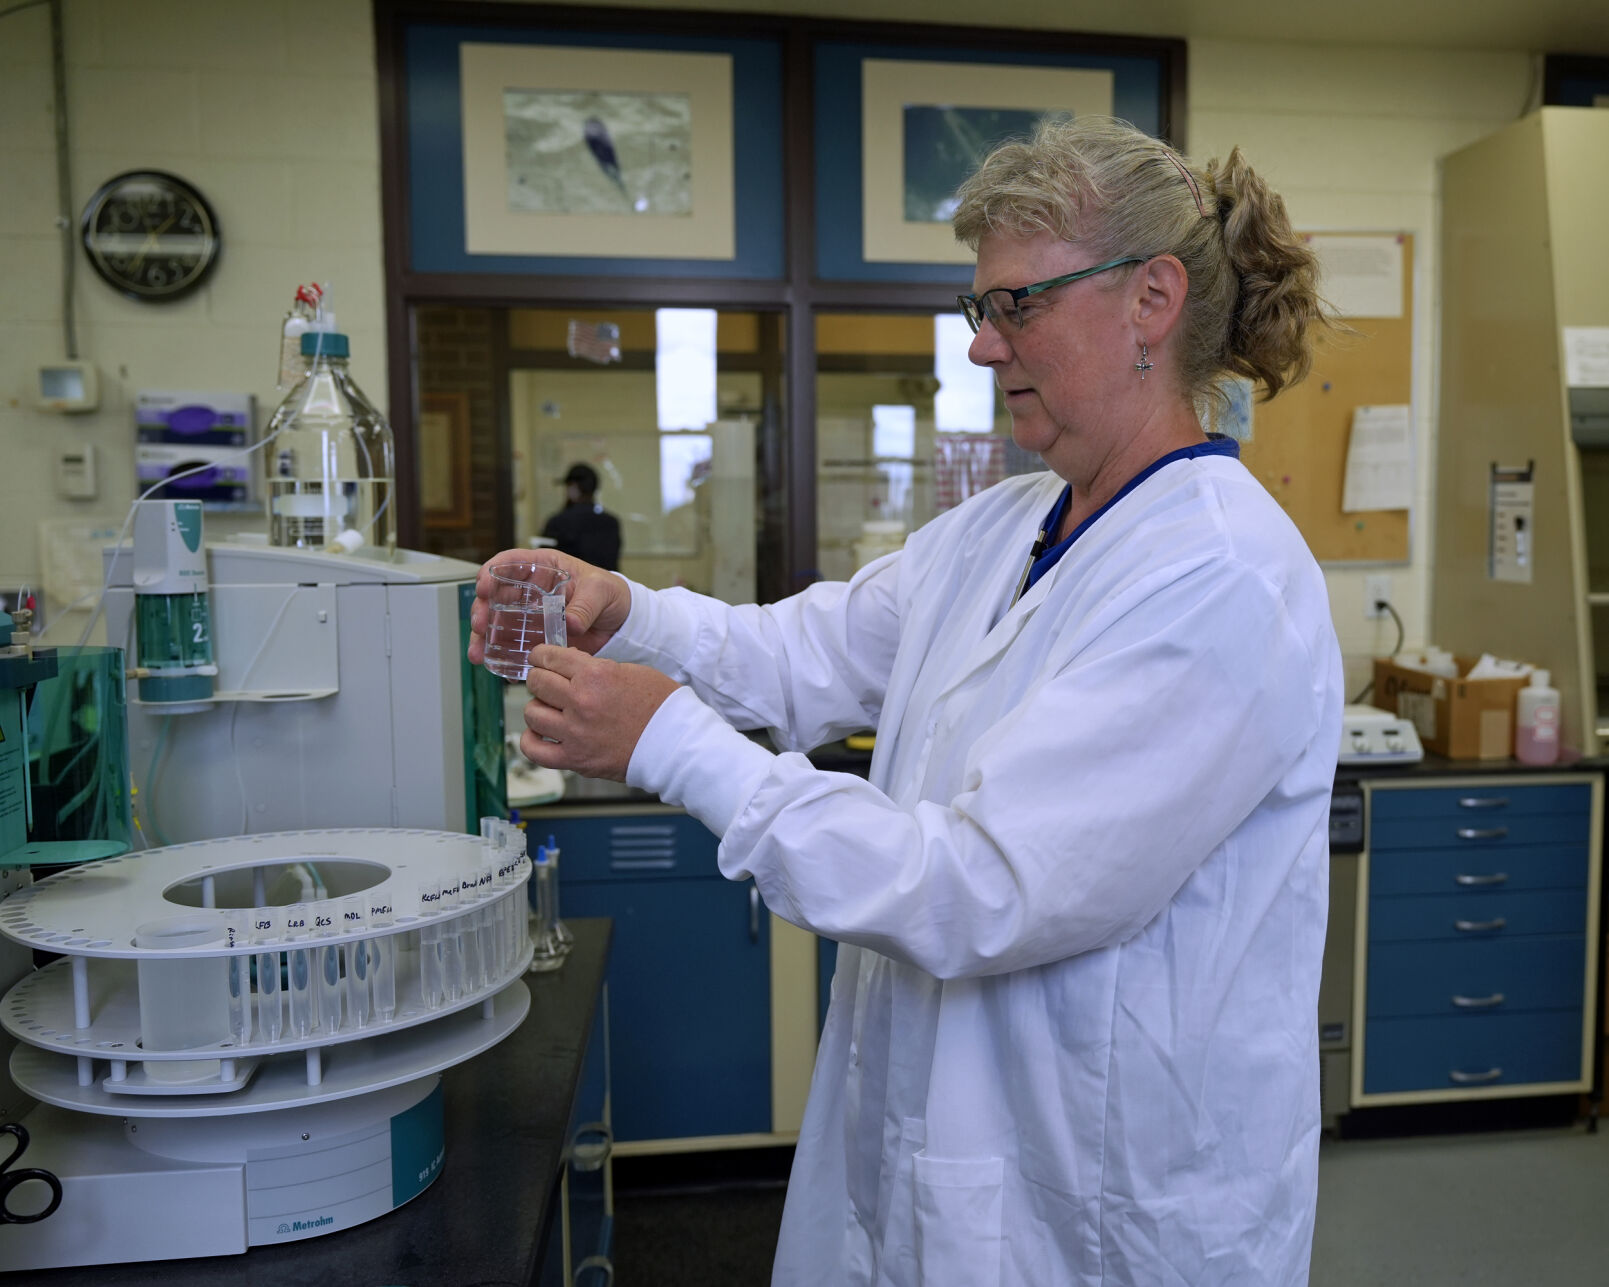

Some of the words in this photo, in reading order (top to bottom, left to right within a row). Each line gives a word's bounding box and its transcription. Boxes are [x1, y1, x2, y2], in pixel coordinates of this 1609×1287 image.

[192, 623, 204, 643] 2
[255, 921, 271, 930] LFB
[287, 919, 305, 928] LRB
[292, 1216, 334, 1232] Metrohm
